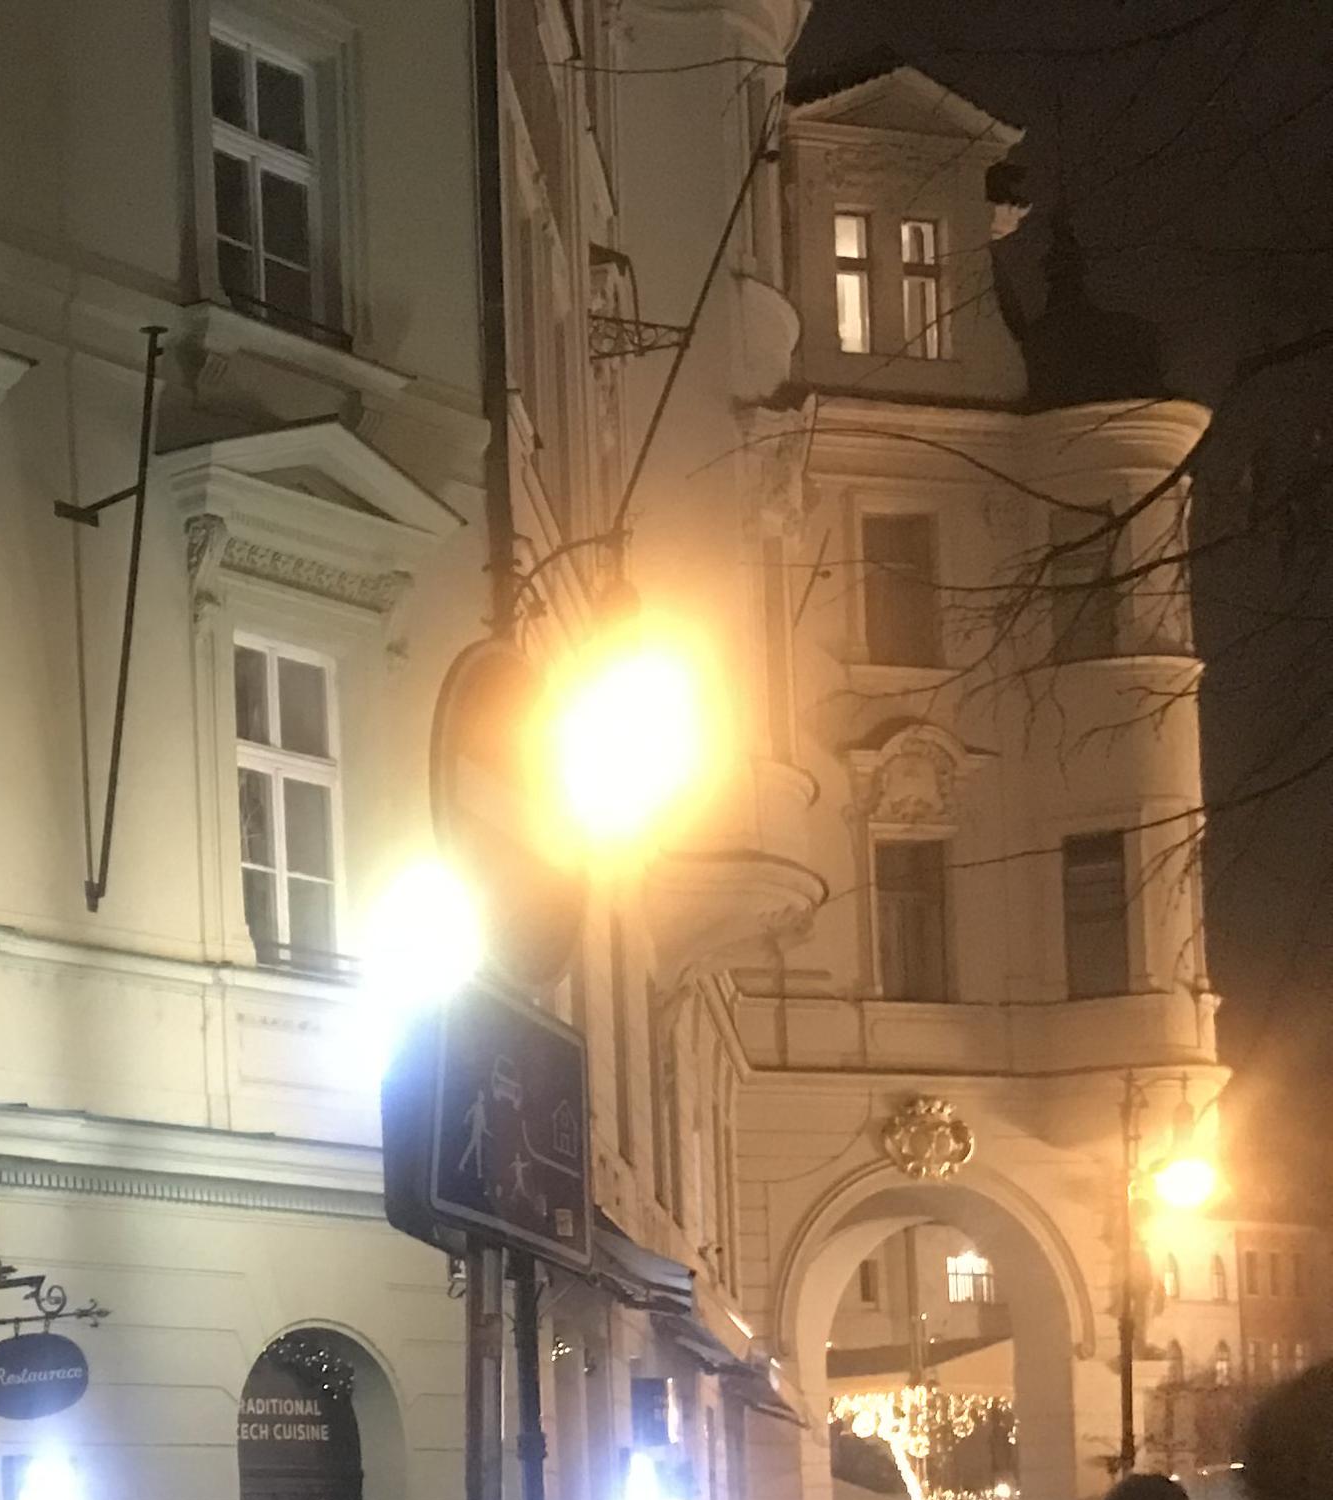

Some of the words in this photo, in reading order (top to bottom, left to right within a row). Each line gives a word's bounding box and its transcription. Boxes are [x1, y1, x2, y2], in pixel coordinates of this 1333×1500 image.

[239, 1398, 322, 1416] RADITIONAL
[237, 1423, 269, 1440] ECH
[273, 1423, 330, 1441] CUISINE
